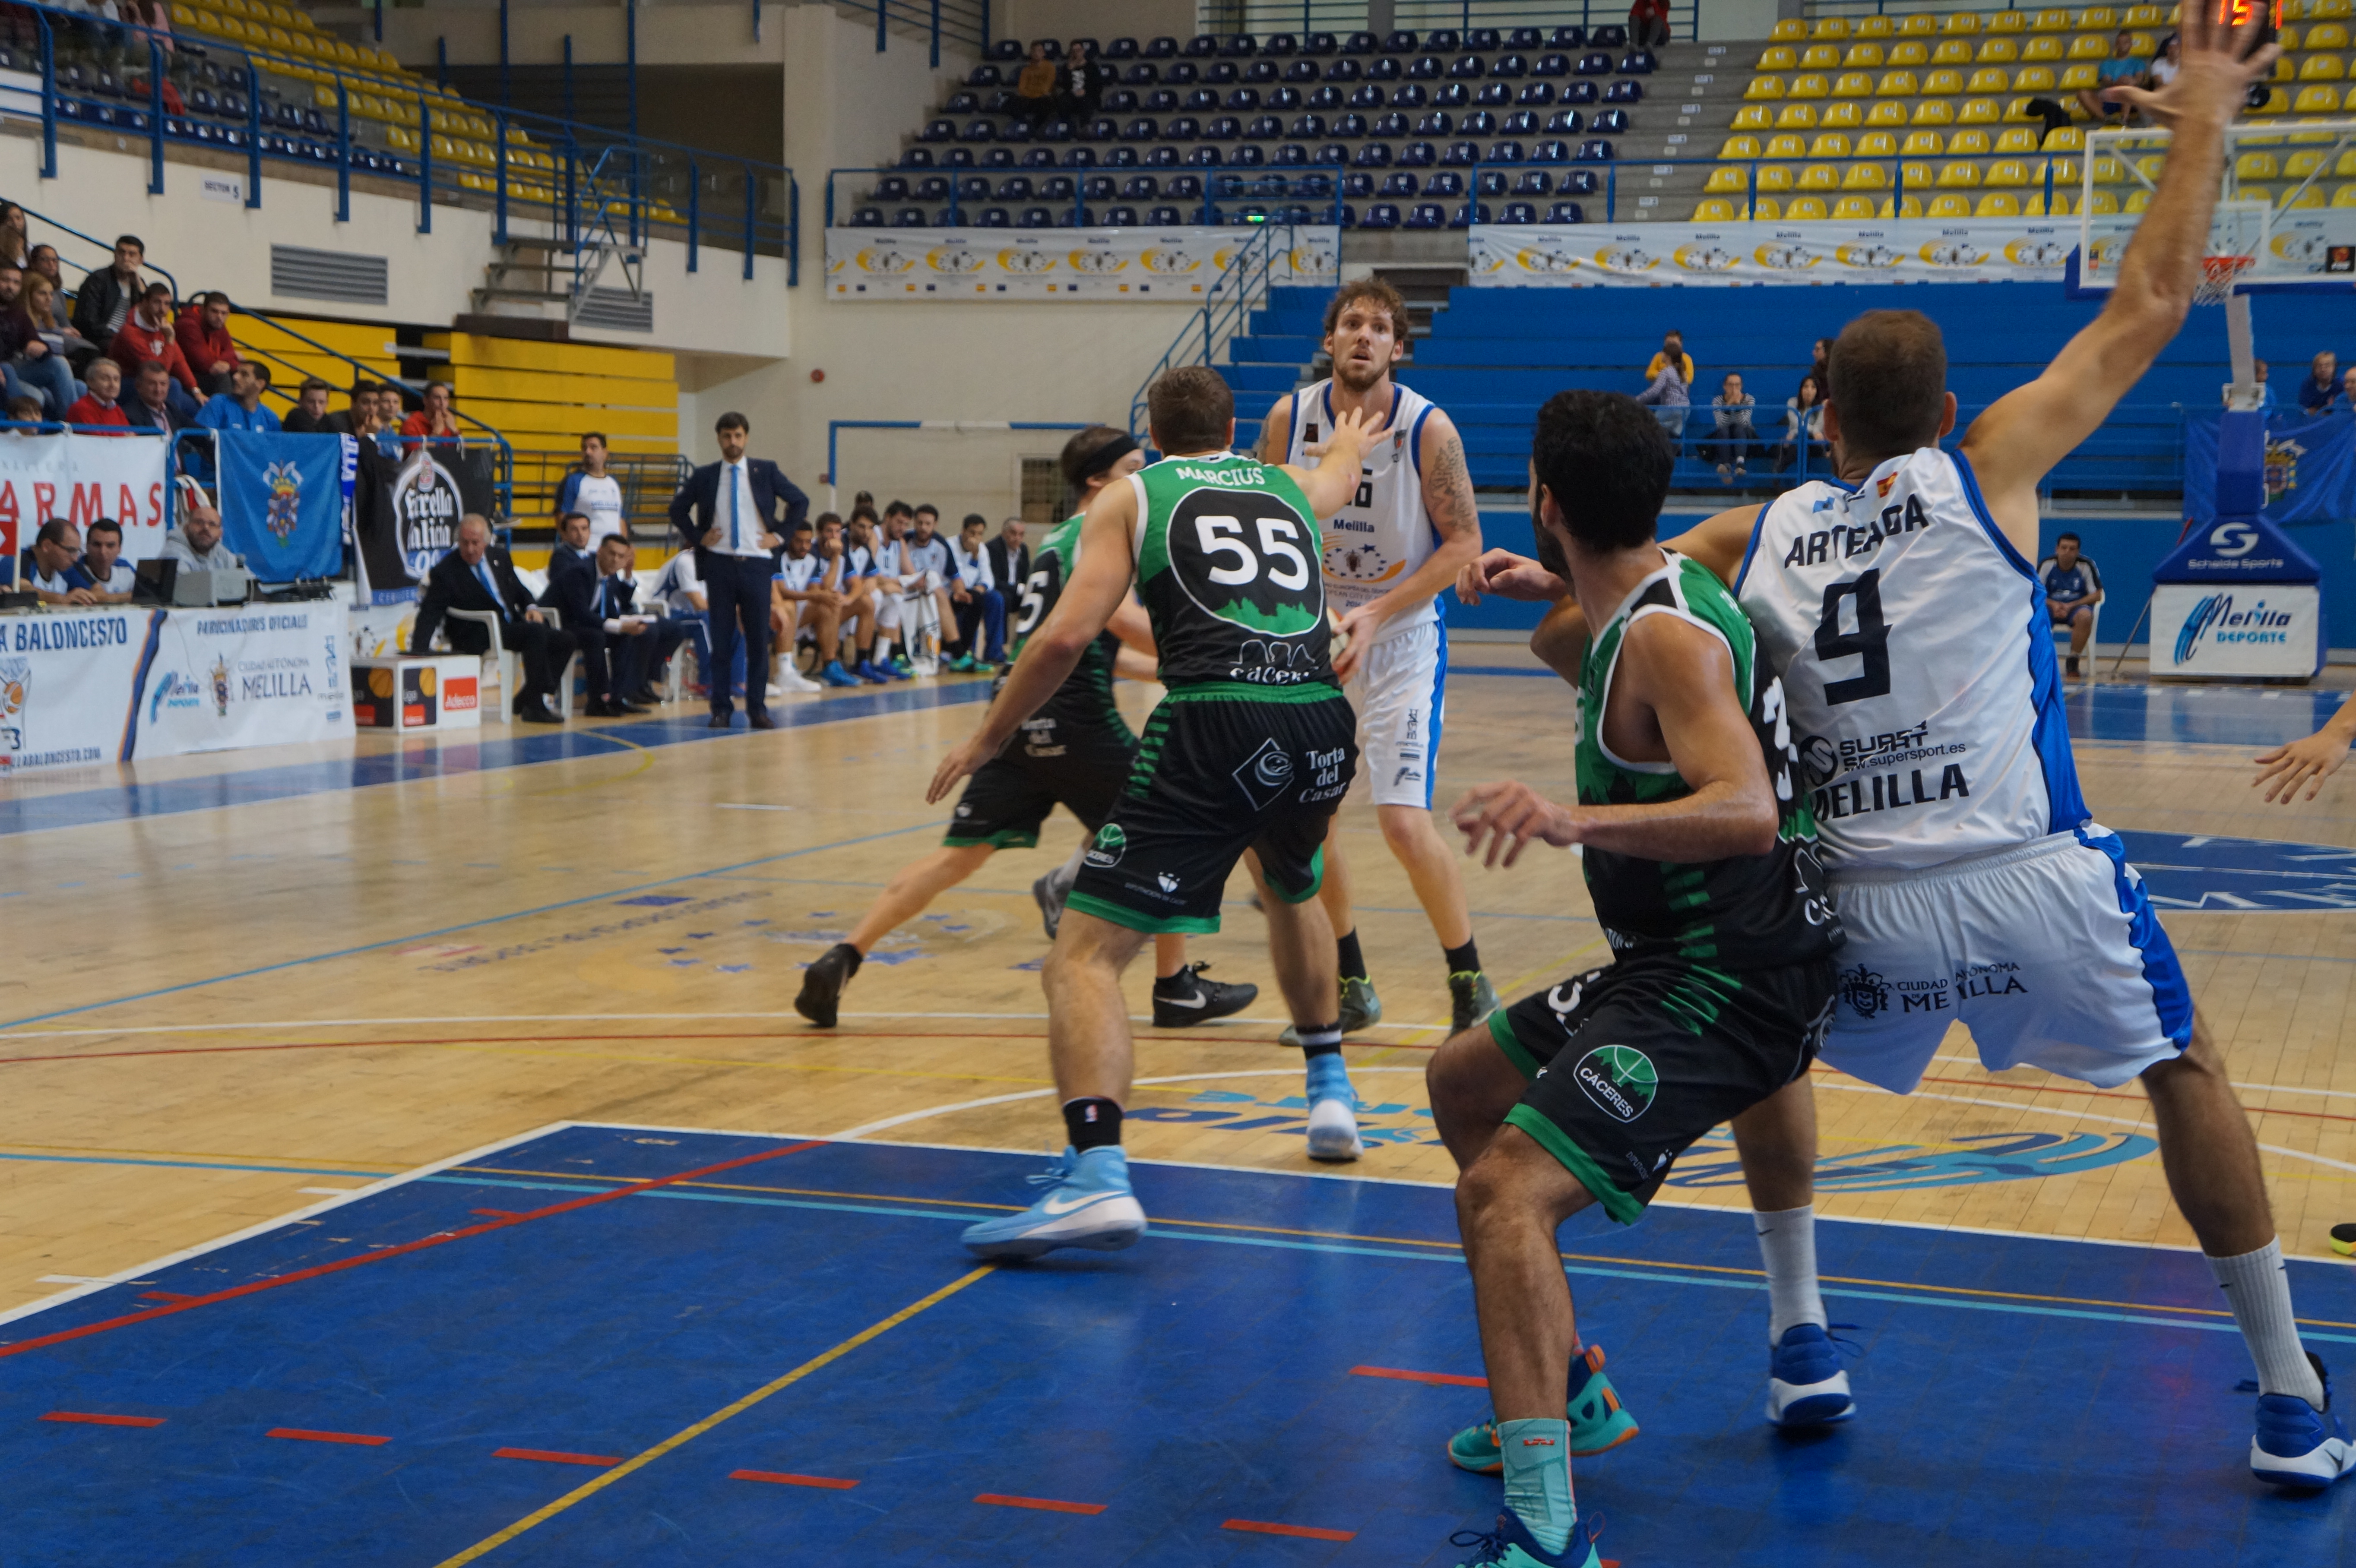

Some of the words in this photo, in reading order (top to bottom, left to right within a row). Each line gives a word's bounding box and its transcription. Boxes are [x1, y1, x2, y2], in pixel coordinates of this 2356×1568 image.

[1175, 467, 1265, 486] MARCIUS
[1333, 519, 1375, 533] Melilla
[1195, 515, 1309, 591] 55
[2241, 558, 2284, 570] Sports
[16, 616, 127, 651] BALONCESTO
[1814, 568, 1894, 706] 9
[2217, 631, 2287, 642] DEPORTE
[242, 673, 312, 701] MELILLA
[445, 693, 476, 708] Adecco
[1305, 747, 1345, 770] Torta
[1316, 764, 1339, 787] del
[1299, 782, 1346, 803] Casar
[1897, 979, 1948, 991] CIUDAD
[1900, 975, 2029, 1013] MEILLA
[1580, 1067, 1634, 1117] CÁCERES
